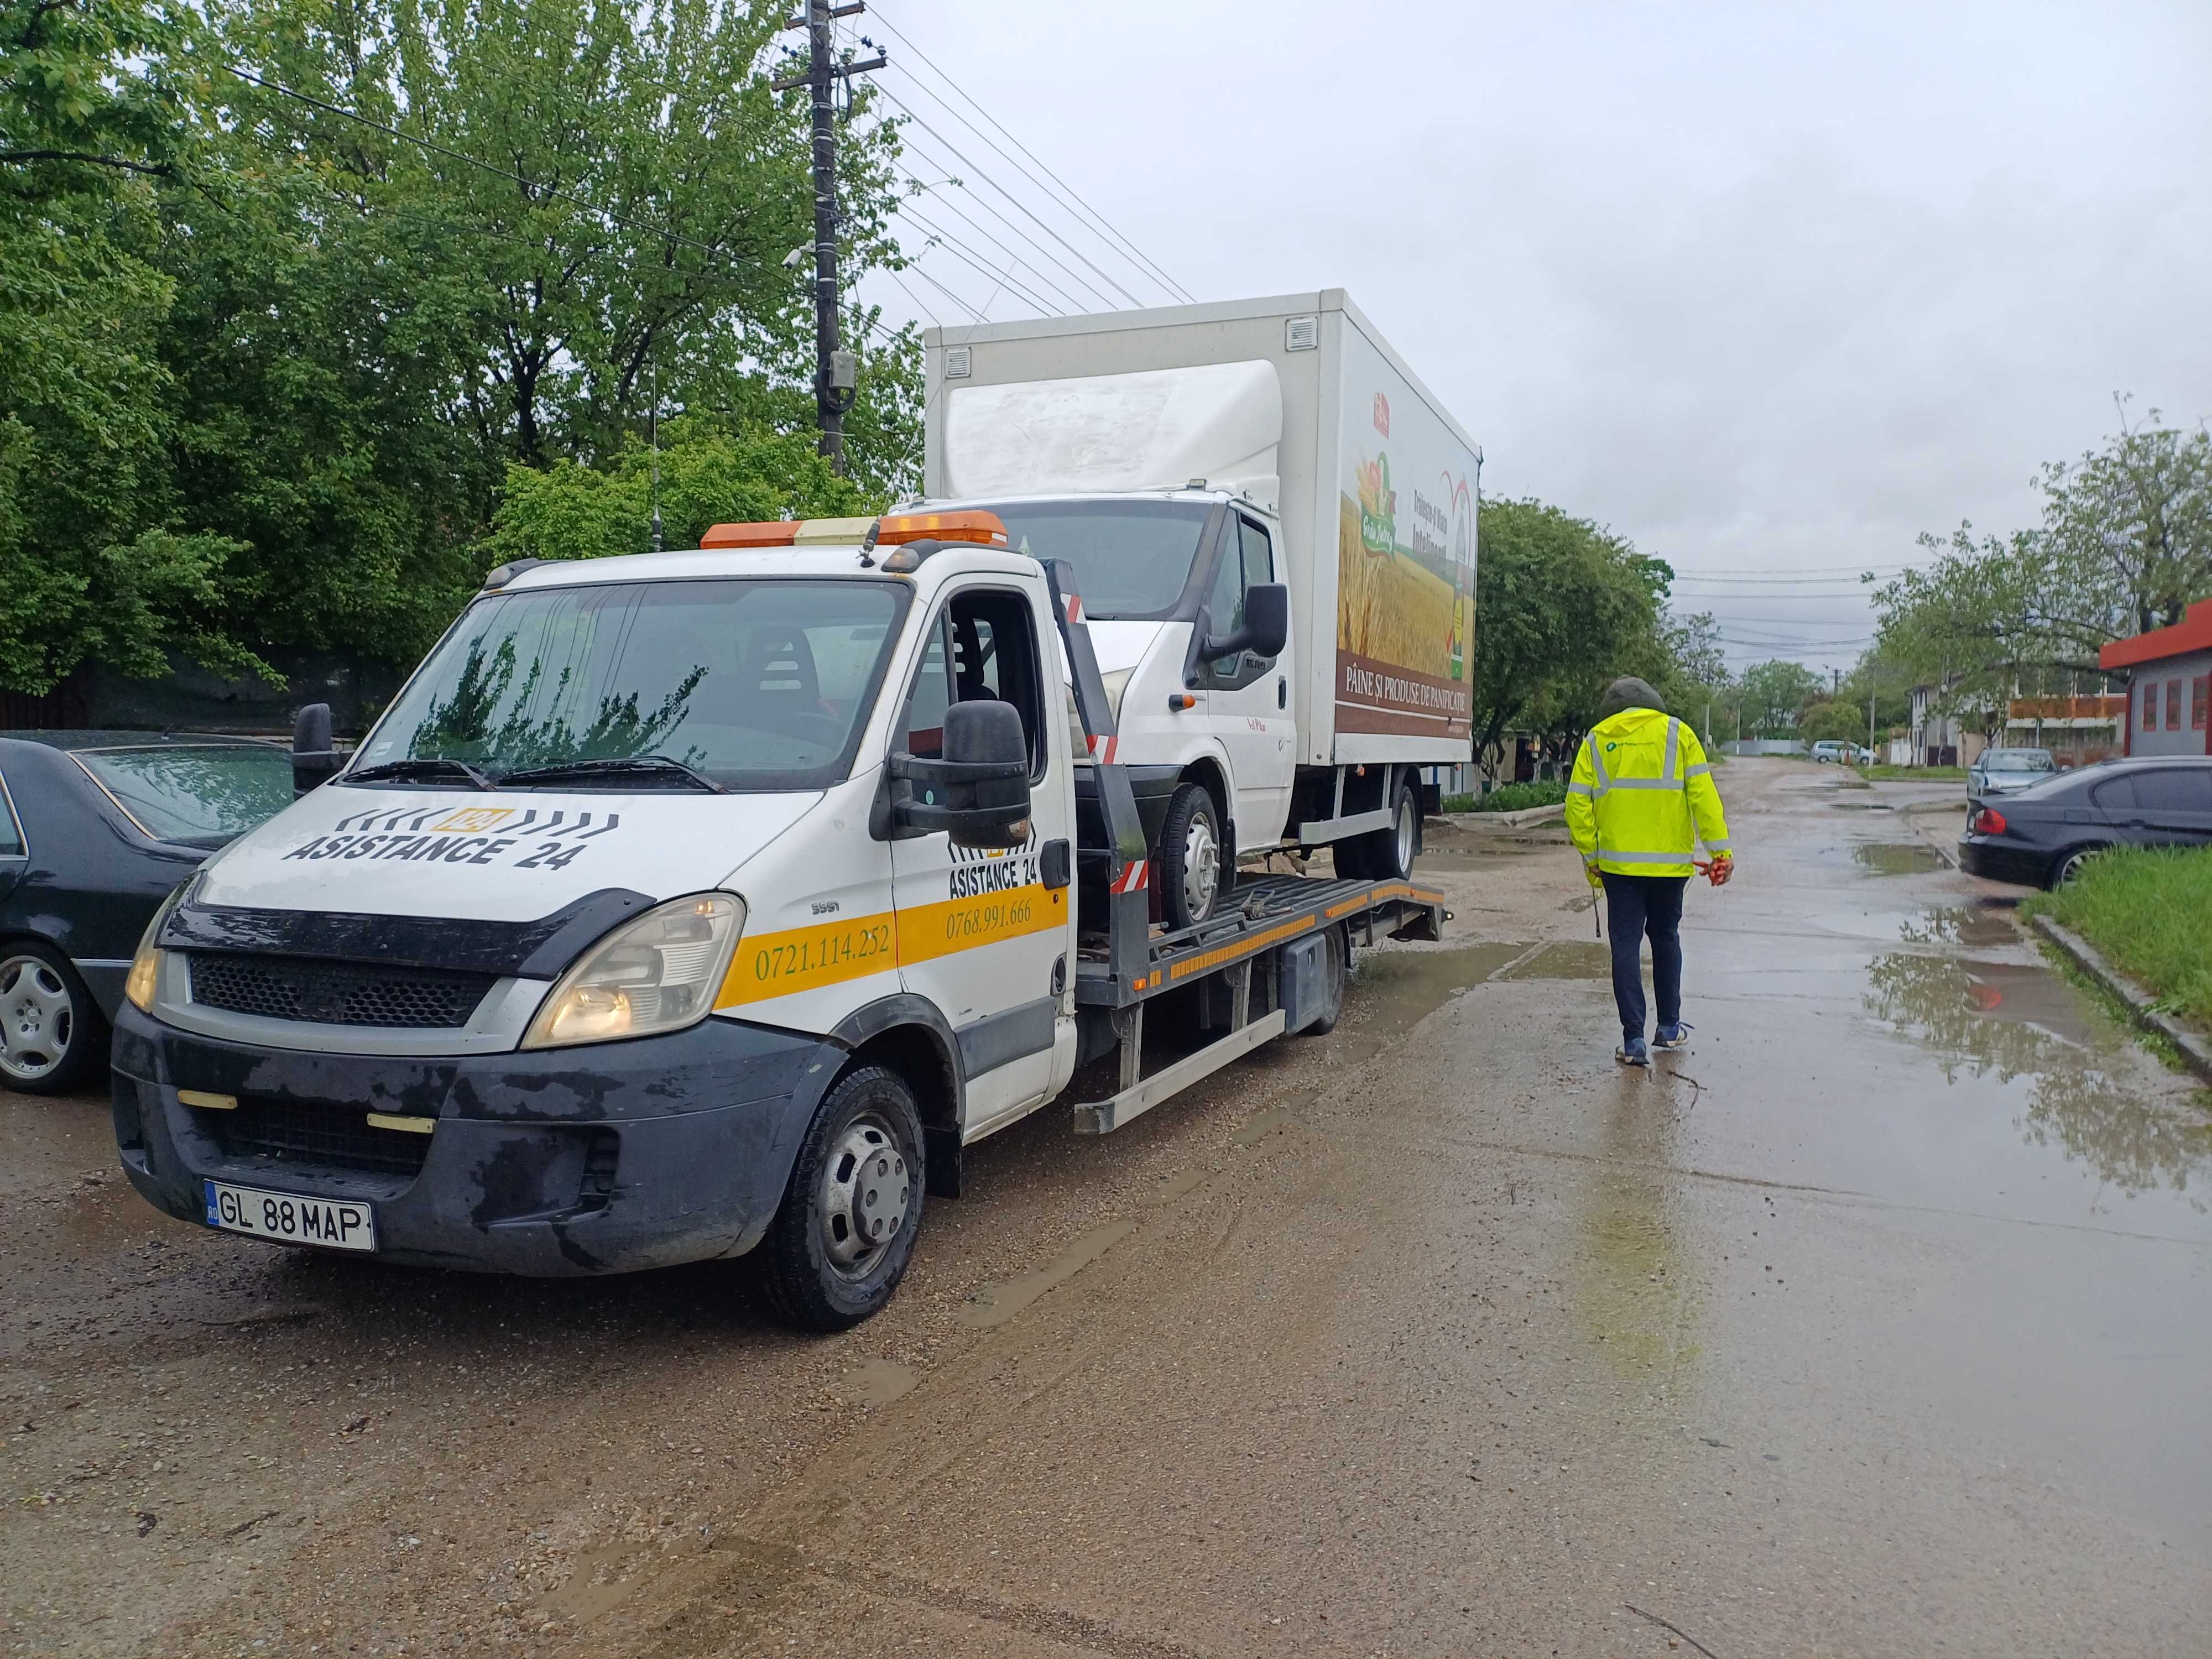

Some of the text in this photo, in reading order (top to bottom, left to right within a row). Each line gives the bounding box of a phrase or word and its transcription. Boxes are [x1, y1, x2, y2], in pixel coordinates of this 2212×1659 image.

[1346, 661, 1373, 696] PÂINE
[1384, 676, 1420, 705] PRODUSE
[1420, 685, 1430, 706] DE
[280, 835, 588, 870] ASISTANCE 24
[949, 857, 1037, 900] ASISTANCE 24
[946, 898, 1032, 940] 0768.991.666
[755, 925, 889, 982] 0721.114.252
[207, 1191, 361, 1242] RO GL 88 MAP
